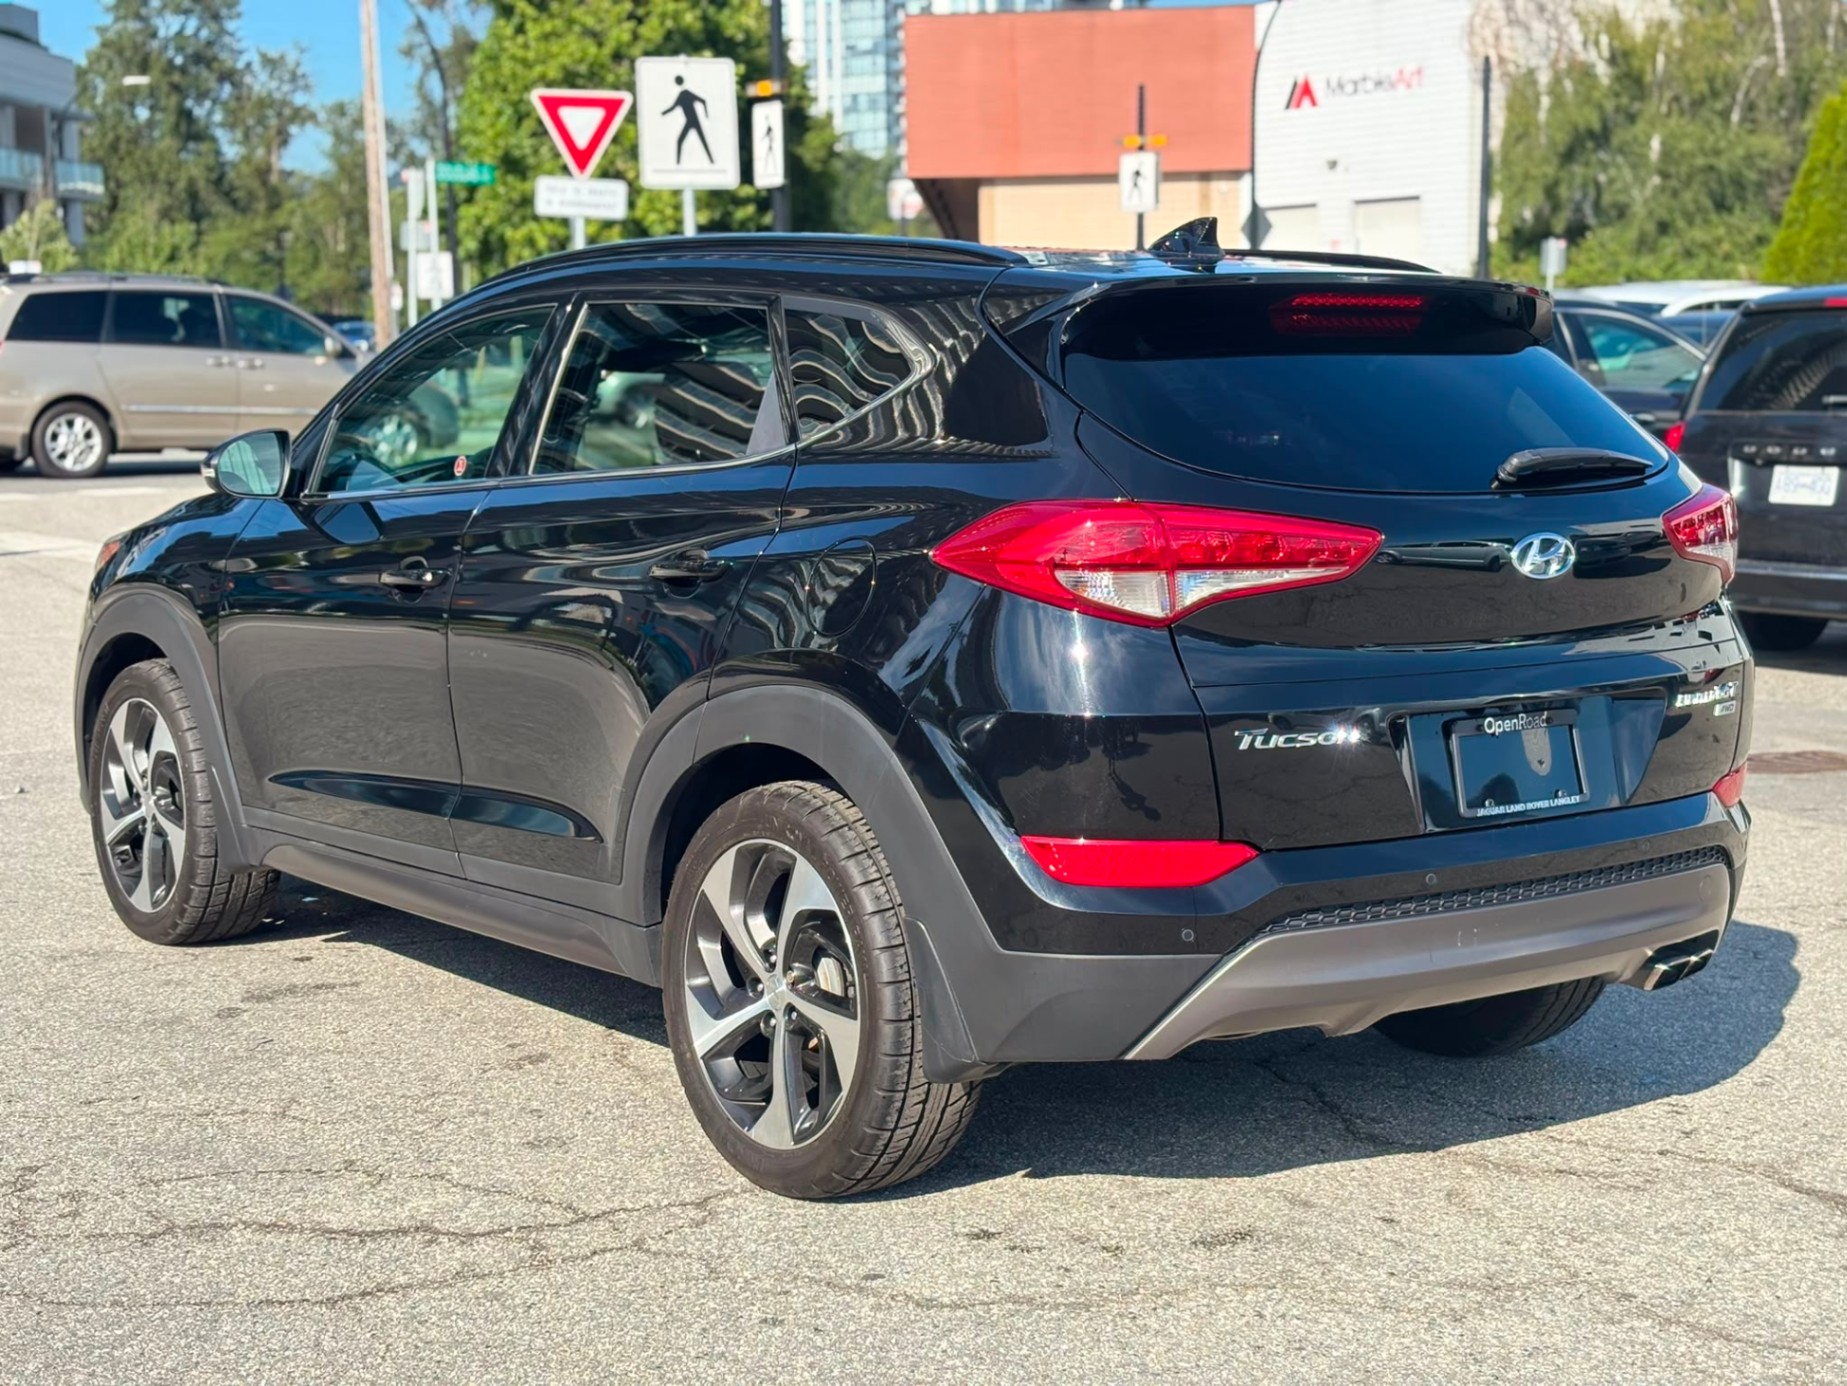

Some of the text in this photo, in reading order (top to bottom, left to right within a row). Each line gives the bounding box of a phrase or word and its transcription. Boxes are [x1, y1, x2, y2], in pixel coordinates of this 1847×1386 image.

[1484, 711, 1548, 736] OpenRoad
[1477, 795, 1580, 817] JAGUAR LAND ROVER LANGLEY
